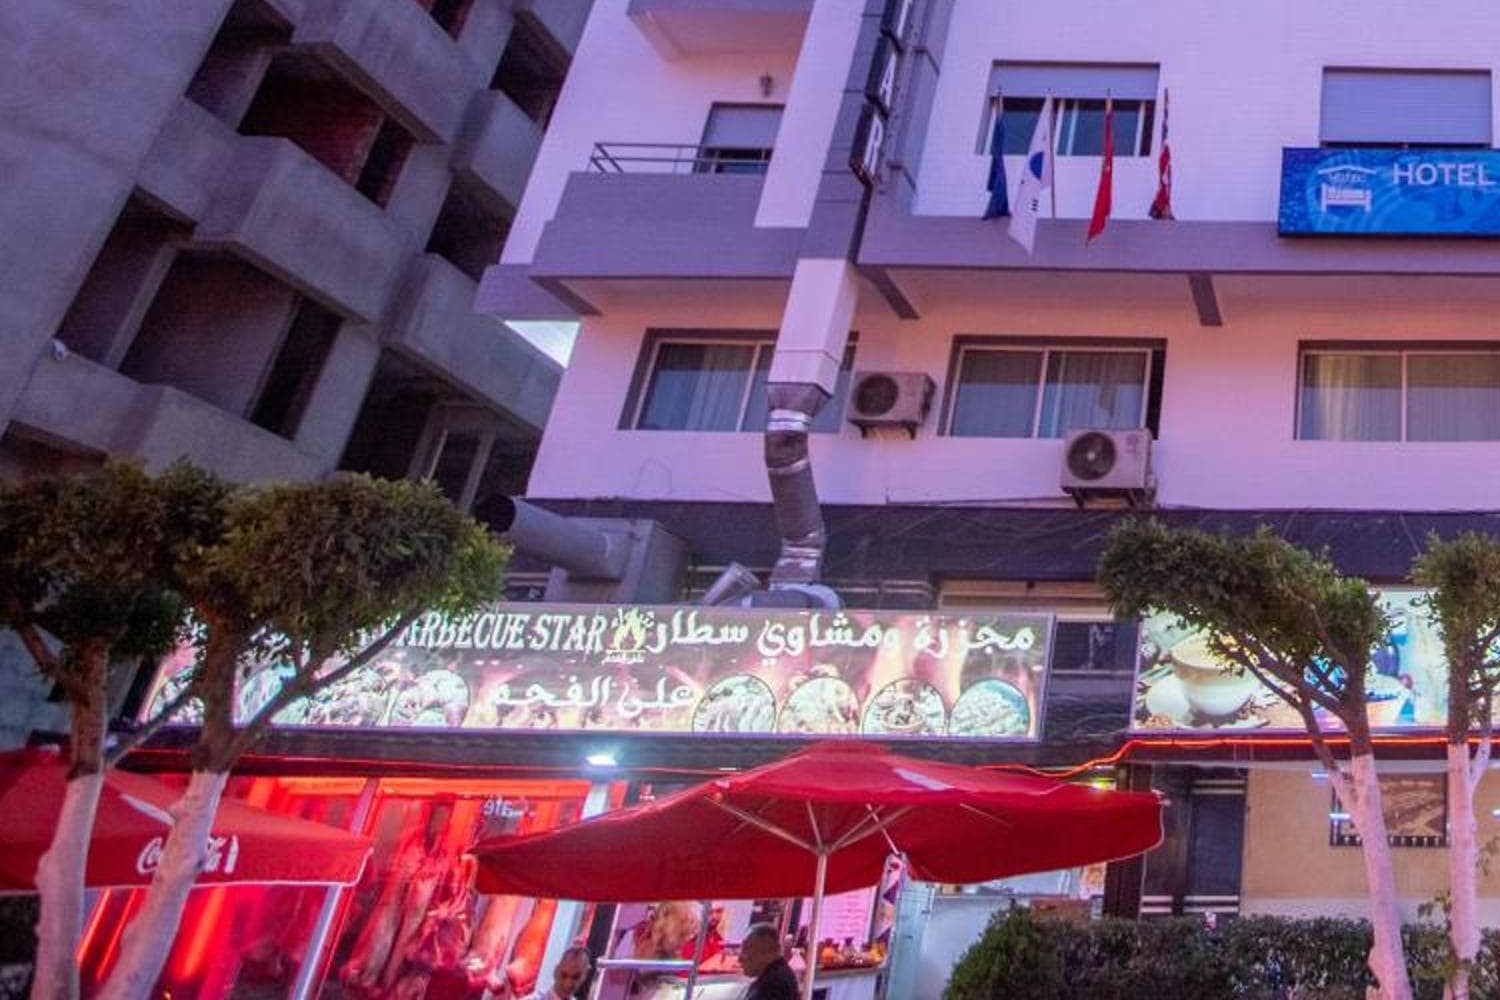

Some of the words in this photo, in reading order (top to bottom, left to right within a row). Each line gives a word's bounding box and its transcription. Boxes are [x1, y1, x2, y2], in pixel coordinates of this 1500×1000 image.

[1393, 162, 1497, 186] HOTEL
[382, 612, 530, 650] ARBECUE
[531, 612, 608, 652] STAR
[645, 609, 750, 653] سطار
[914, 613, 1036, 663] مجزرة
